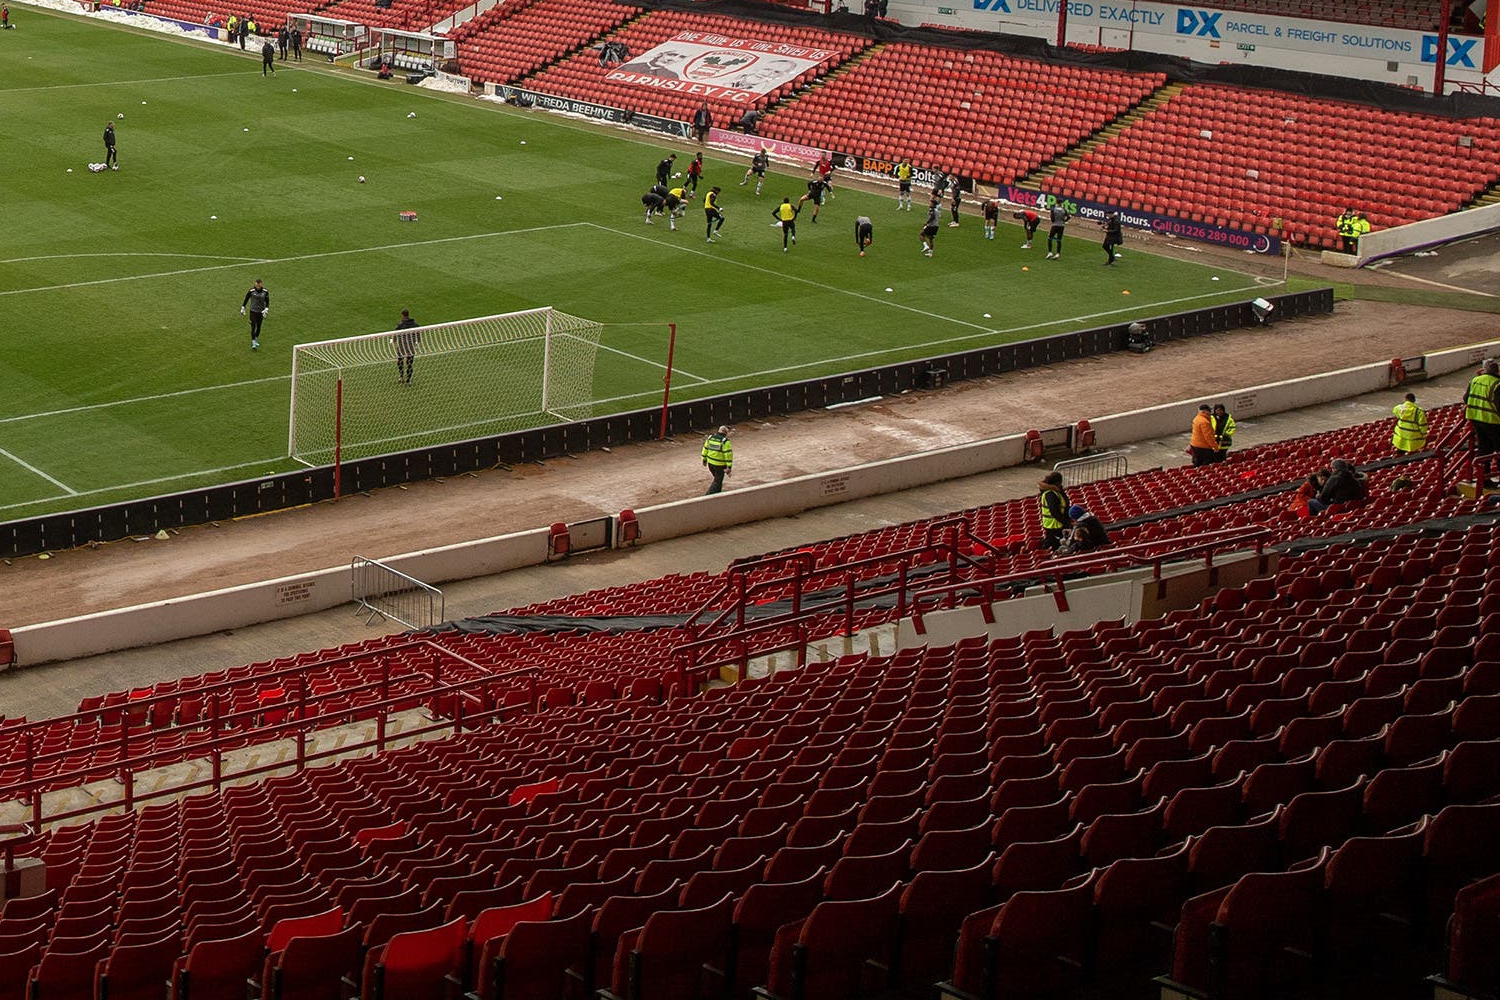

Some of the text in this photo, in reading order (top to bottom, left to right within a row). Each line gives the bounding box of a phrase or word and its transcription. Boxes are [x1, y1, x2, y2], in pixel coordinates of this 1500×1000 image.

[1100, 6, 1165, 25] EXACTLY
[1176, 9, 1412, 52] DX PARCEL & FREIGHT SOLUTIONS
[677, 31, 702, 42] ONE
[702, 33, 728, 46] MADE
[729, 39, 747, 48] US
[810, 49, 829, 59] US
[1421, 35, 1477, 68] DX
[607, 72, 750, 102] BARNSLEY FC
[572, 103, 614, 119] BEEHIVE
[718, 131, 756, 145] your space
[781, 144, 820, 157] your space
[863, 160, 892, 175] BAPP
[1008, 187, 1077, 214] Vets4Pts
[1080, 206, 1105, 218] open
[1120, 212, 1150, 228] hours.
[1153, 219, 1172, 231] Call
[1174, 223, 1205, 238] 01226
[1208, 229, 1227, 242] 289
[1229, 234, 1249, 247] 000
